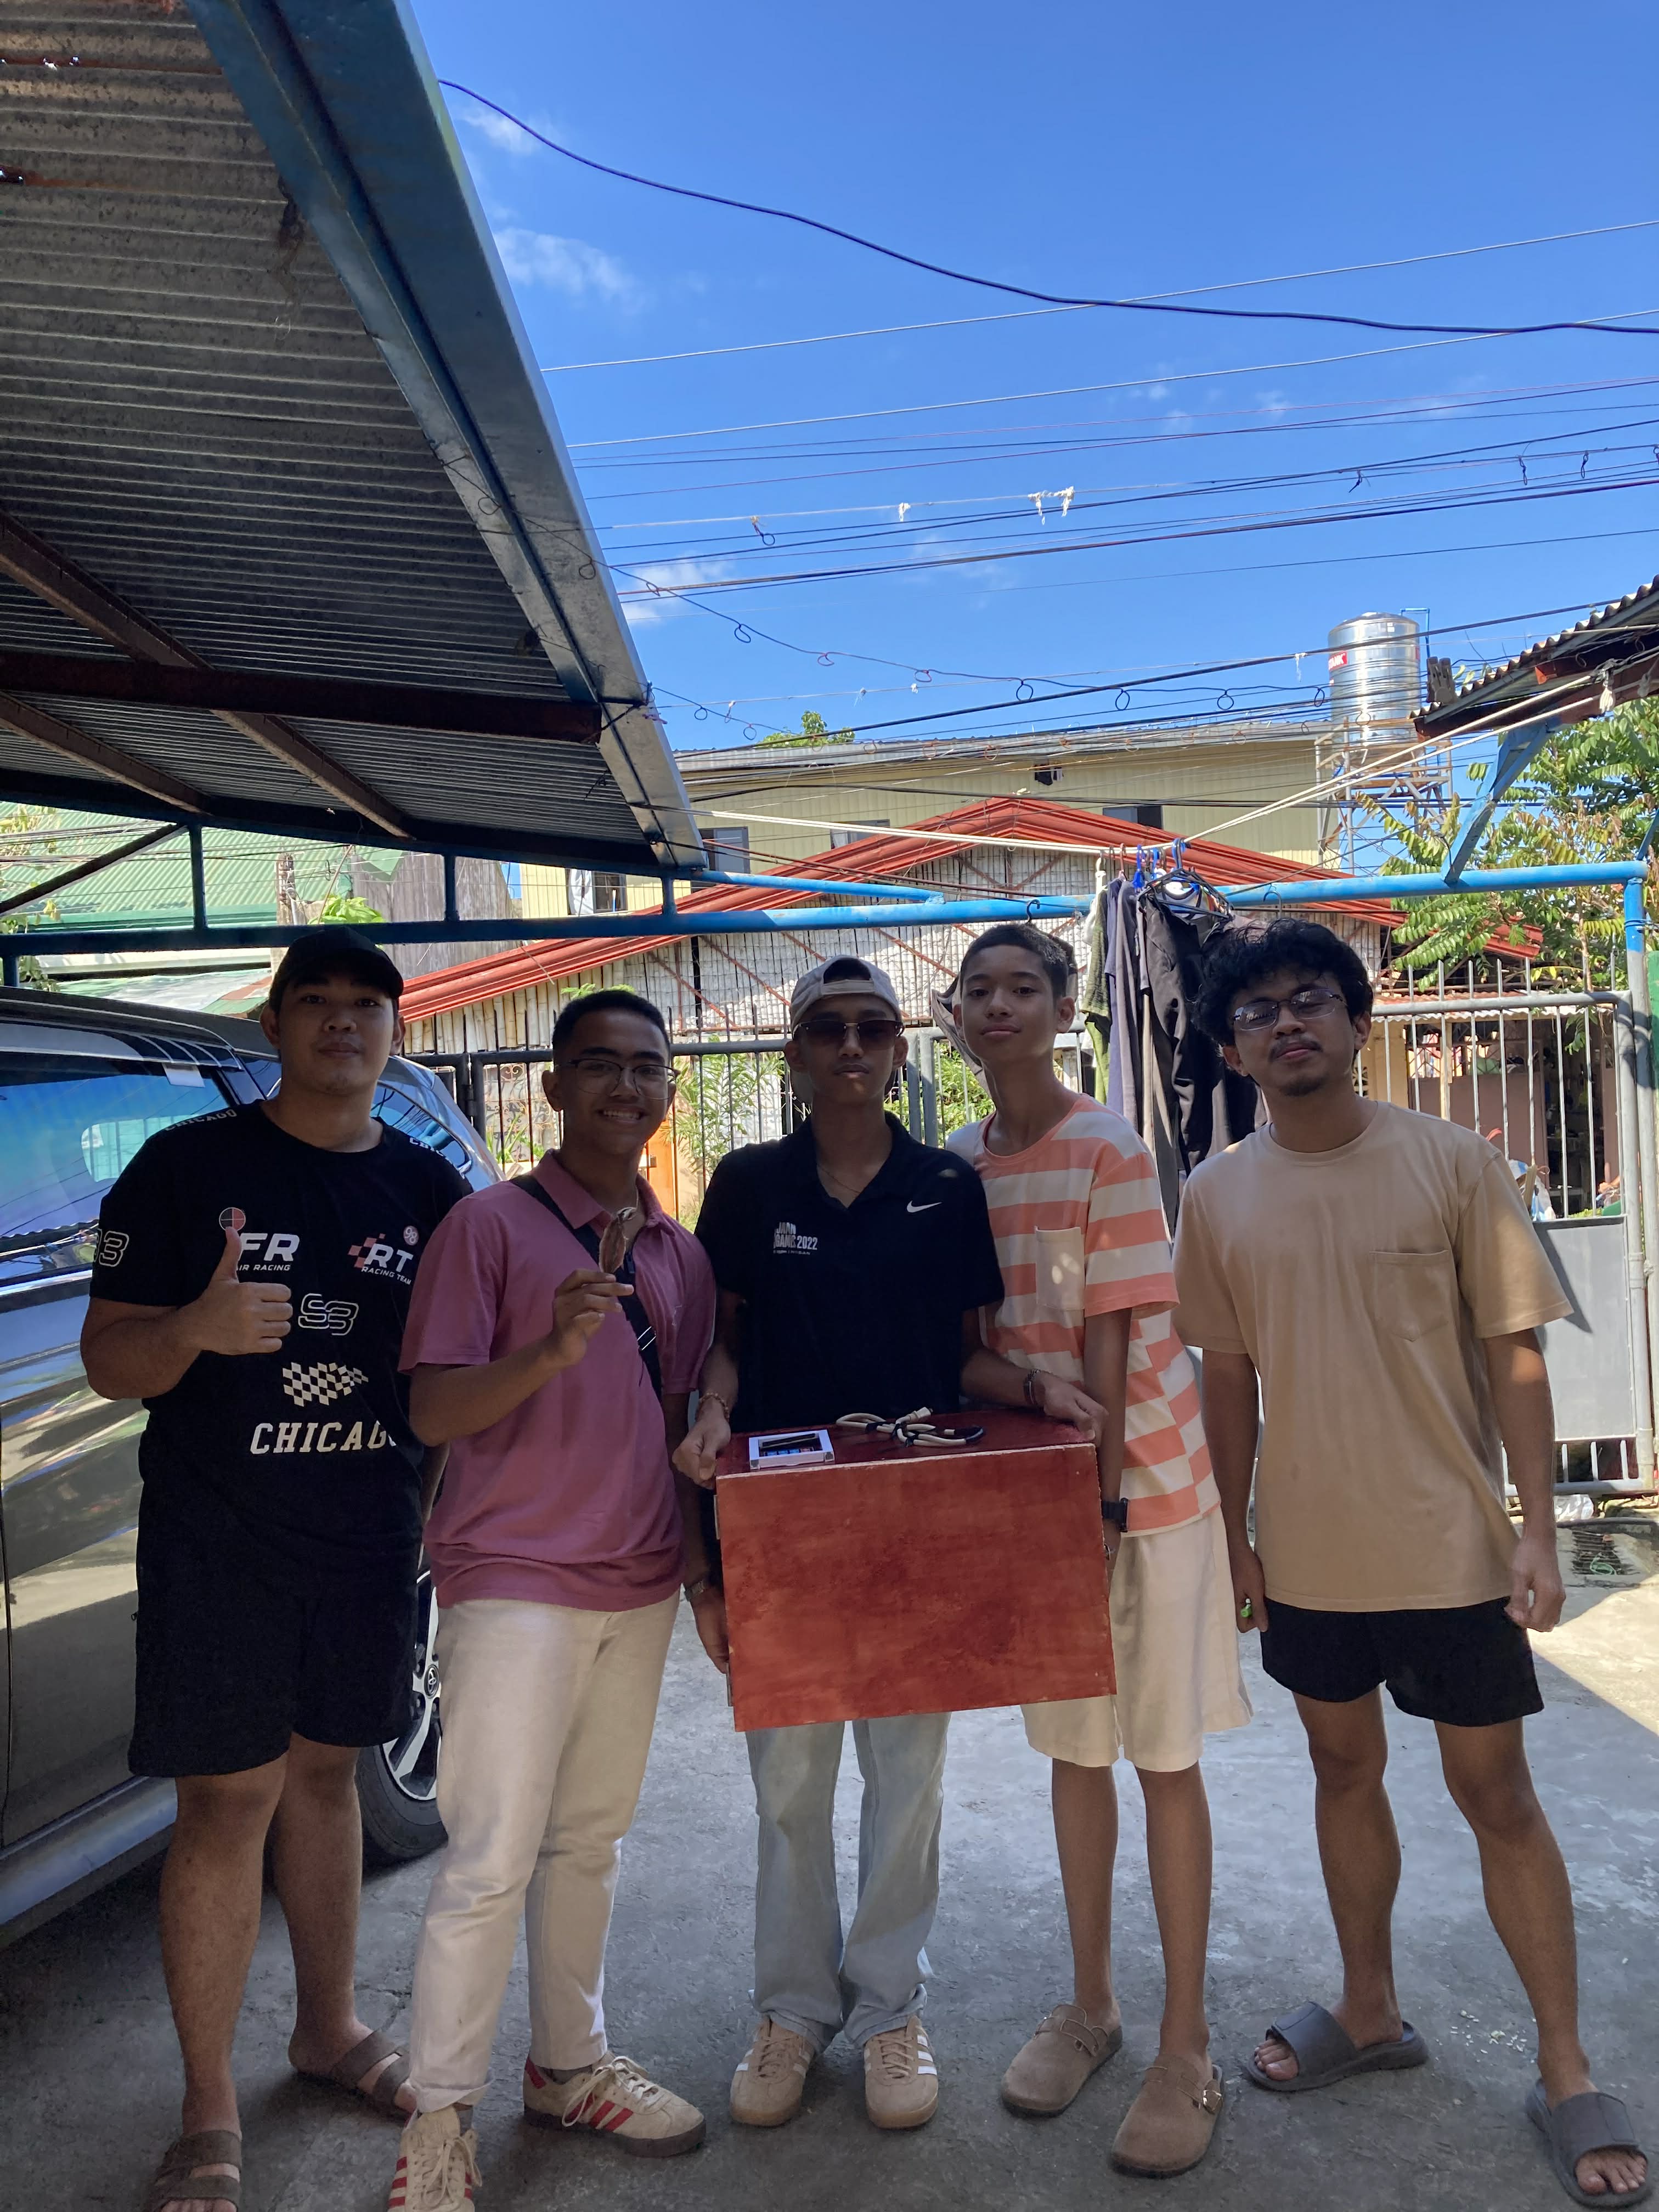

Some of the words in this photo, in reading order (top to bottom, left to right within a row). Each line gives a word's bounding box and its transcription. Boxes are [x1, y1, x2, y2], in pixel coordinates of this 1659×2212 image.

[405, 1227, 417, 1244] 98
[797, 1235, 817, 1250] 2022
[364, 1243, 414, 1272] RT
[361, 1266, 395, 1277] RACING
[397, 1273, 412, 1284] TEAM
